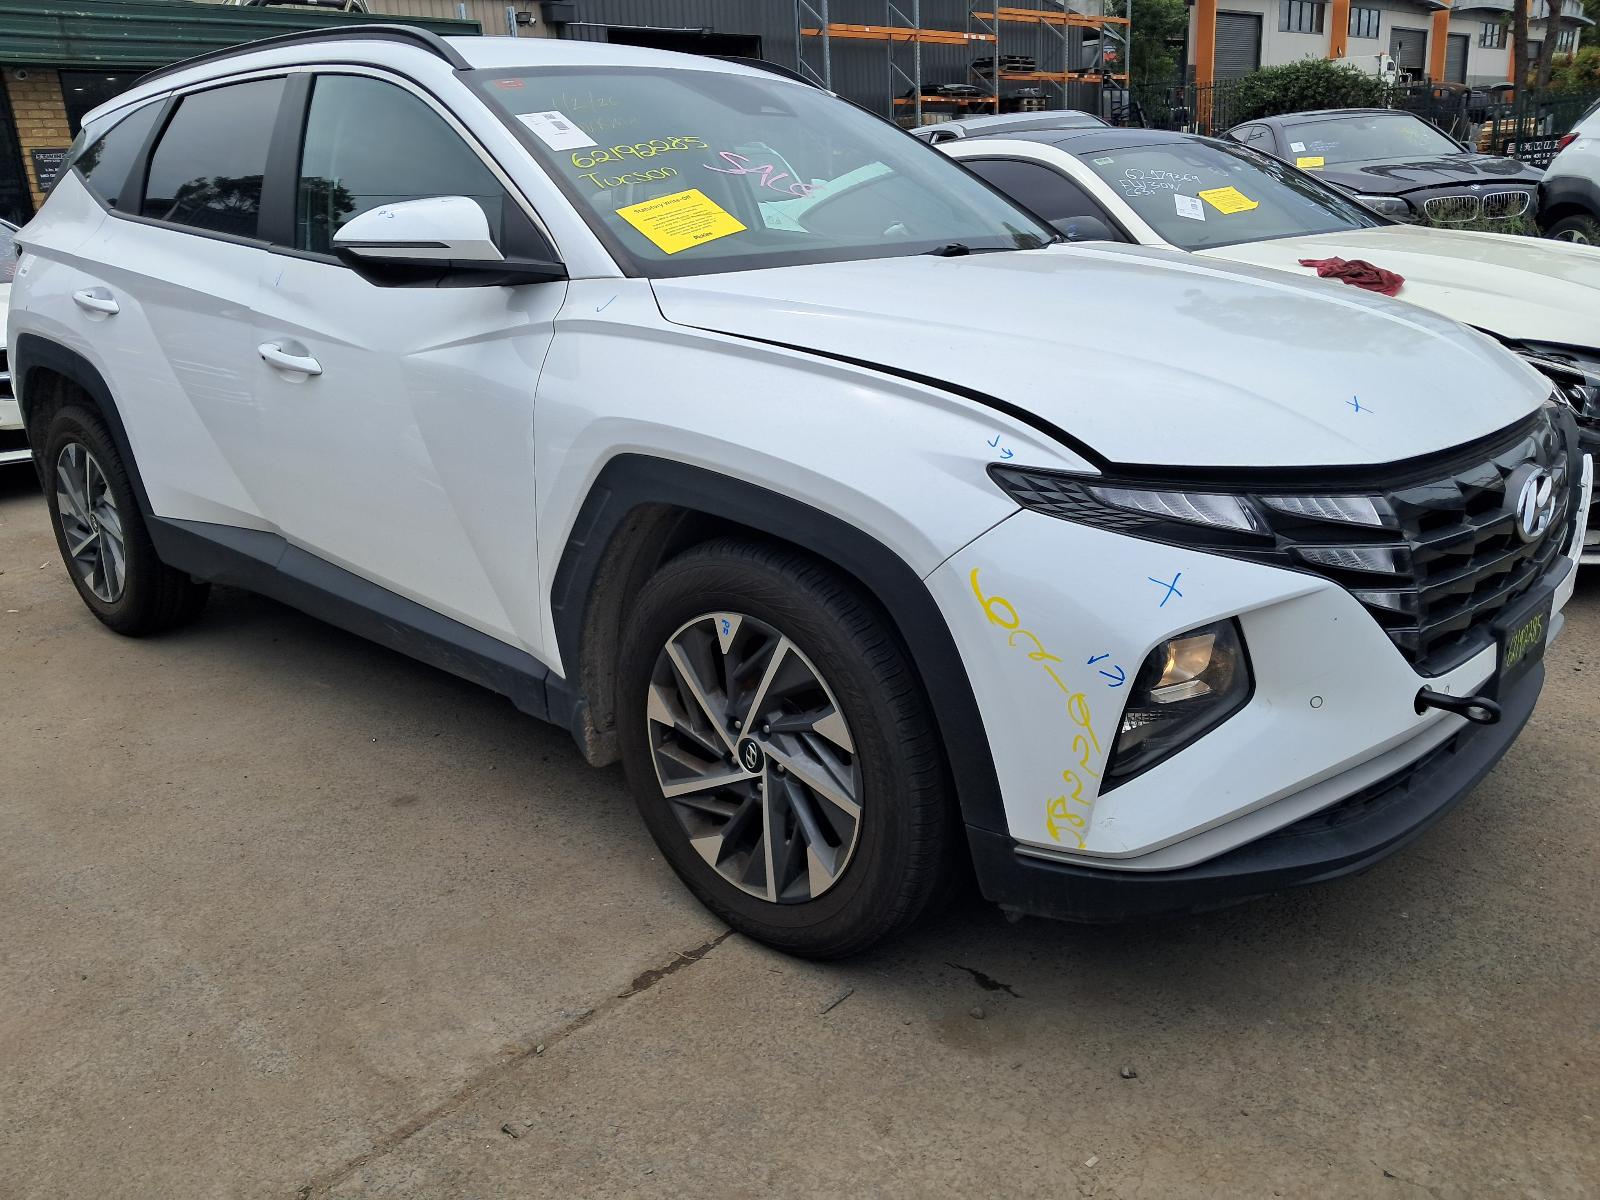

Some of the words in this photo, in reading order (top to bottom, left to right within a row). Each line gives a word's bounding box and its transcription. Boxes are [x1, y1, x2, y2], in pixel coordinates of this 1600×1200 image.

[571, 136, 709, 168] 62192285
[577, 166, 678, 189] Tucson
[633, 201, 665, 214] Statutory
[664, 194, 692, 207] Write-Off
